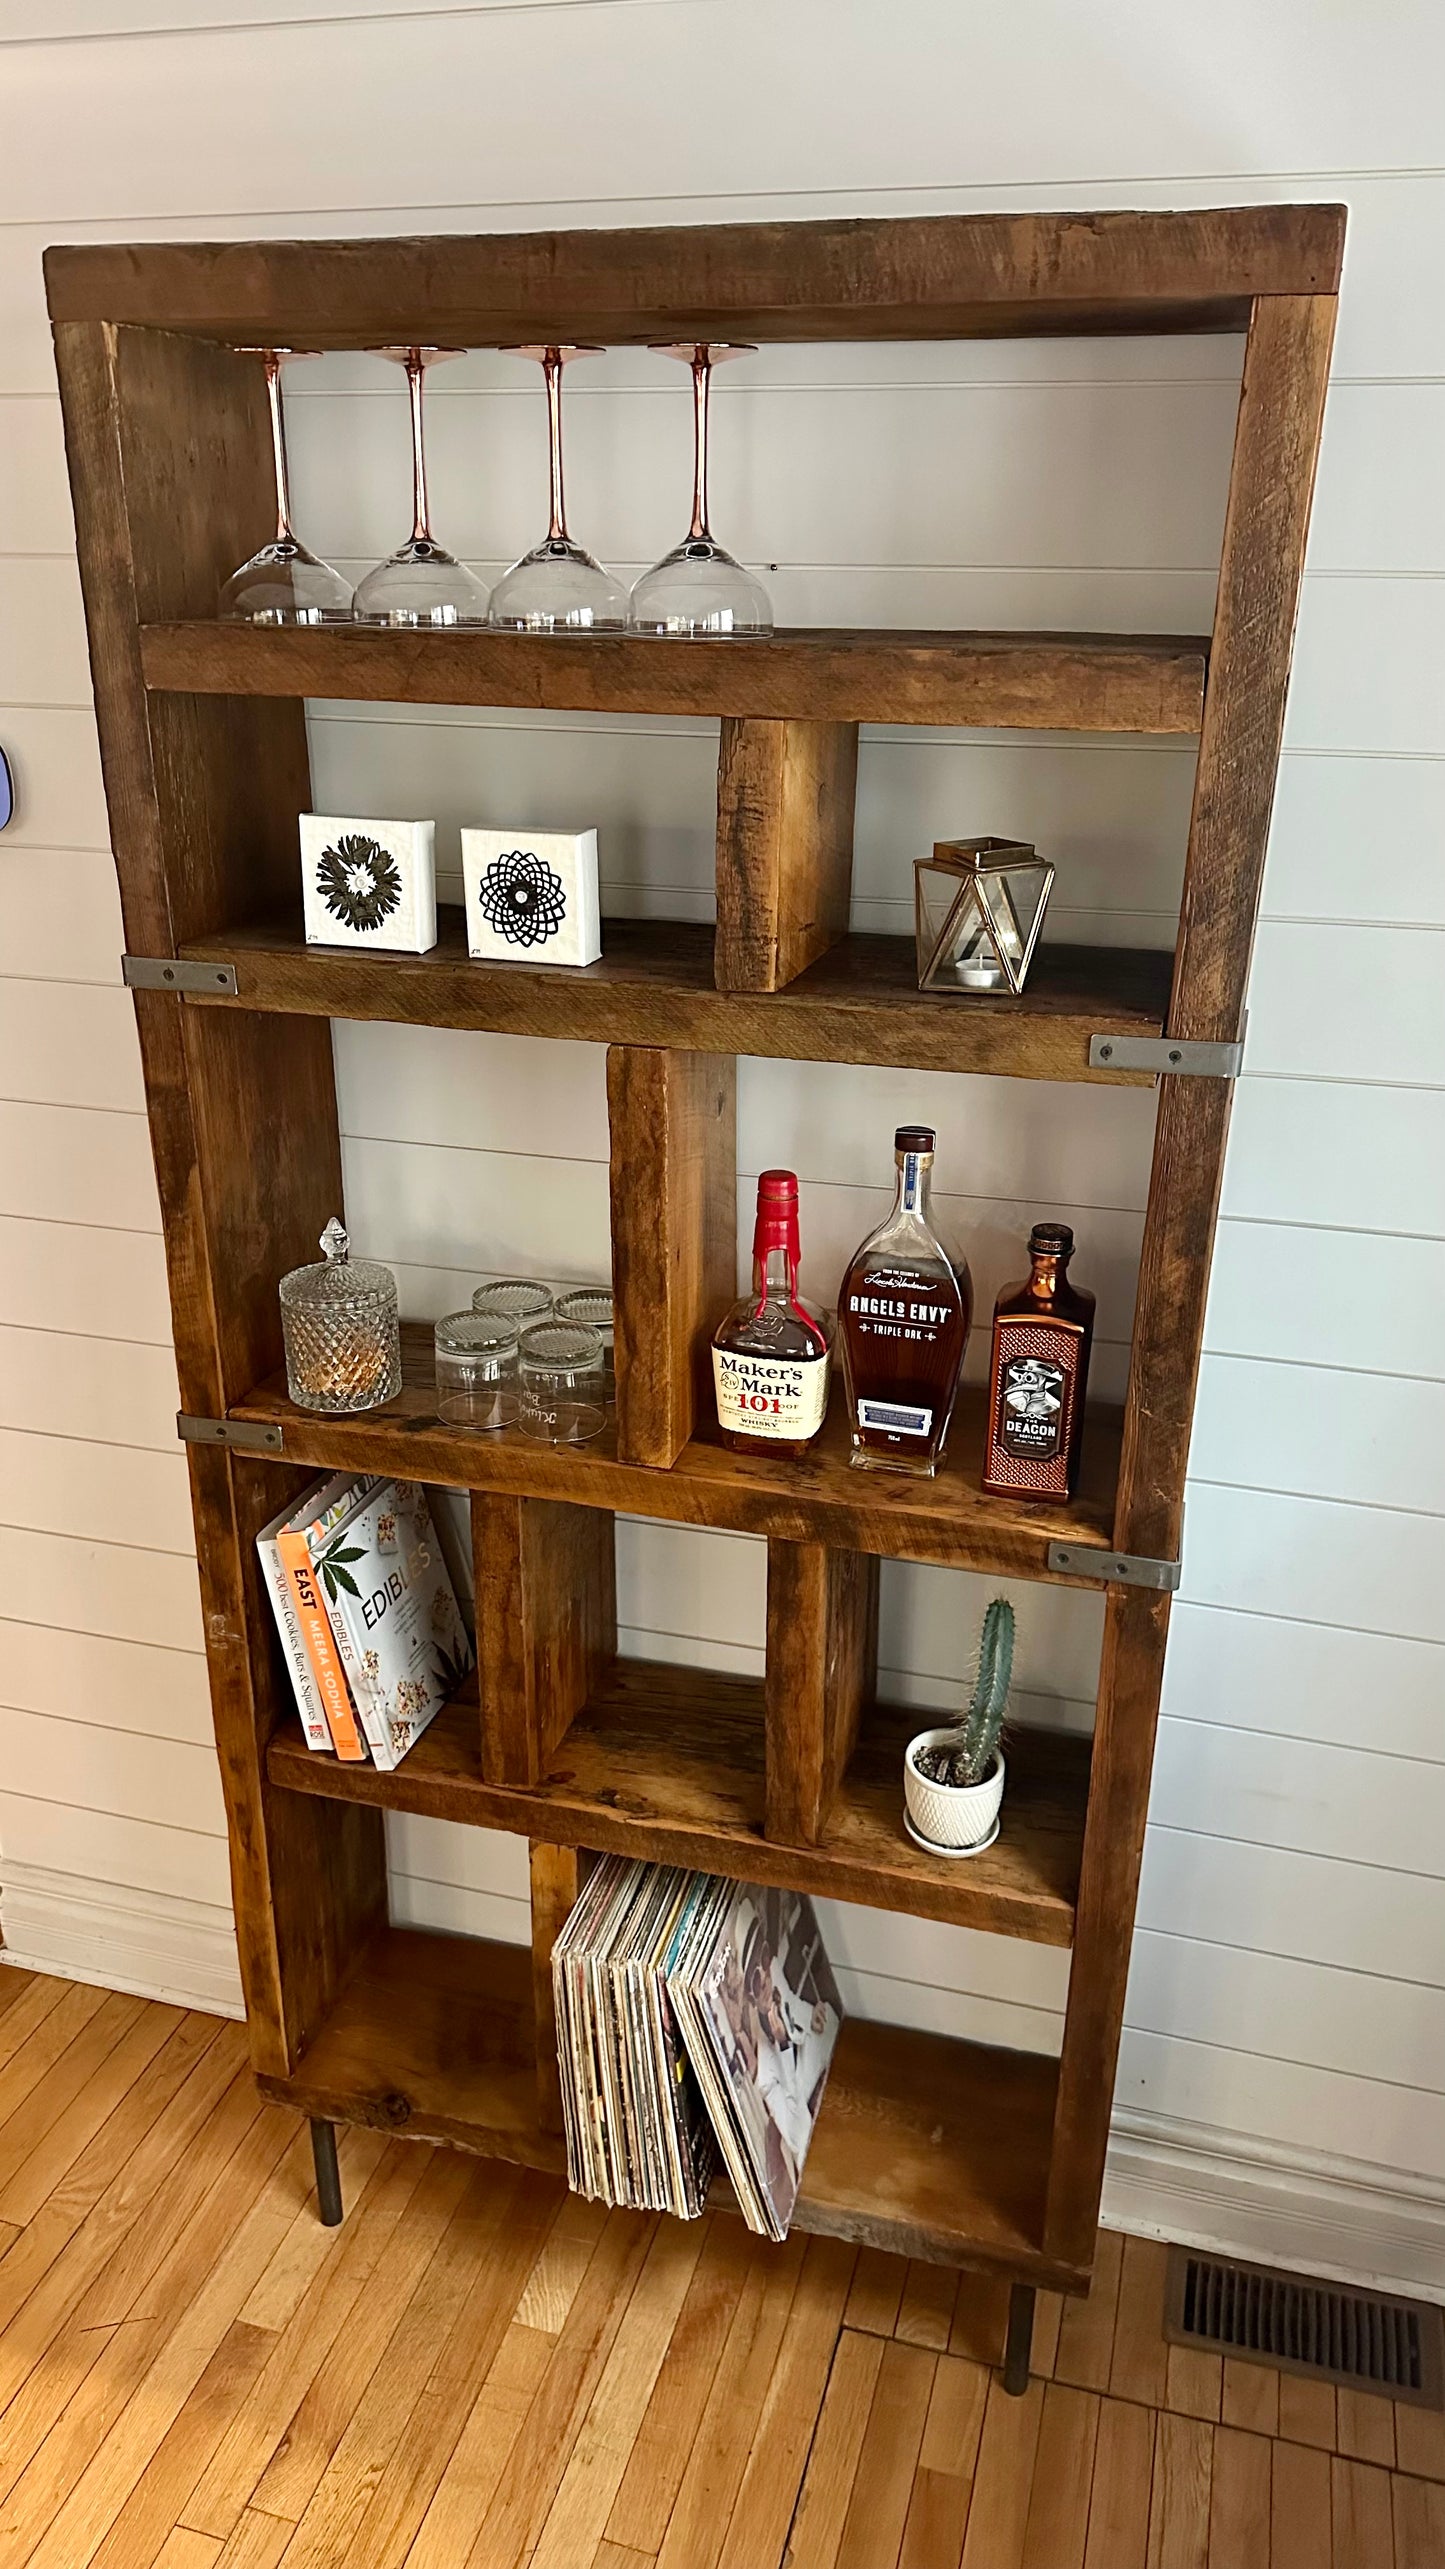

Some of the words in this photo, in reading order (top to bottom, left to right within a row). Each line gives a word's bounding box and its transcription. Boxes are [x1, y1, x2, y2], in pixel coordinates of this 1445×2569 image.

[910, 1303, 948, 1323] ENVY
[873, 1324, 902, 1337] TRIPLE
[904, 1328, 922, 1340] OAK
[719, 1355, 803, 1380] Maker's
[740, 1377, 801, 1397] Mark
[737, 1393, 783, 1414] 101
[740, 1417, 778, 1428] WHISKY
[1006, 1420, 1056, 1437] DEACON
[273, 1573, 288, 1592] 500
[361, 1542, 431, 1631] EDIBLES
[279, 1593, 290, 1610] best
[283, 1611, 302, 1651] Cookies,
[330, 1612, 354, 1661] EDIBLES
[293, 1568, 317, 1609] EAST
[308, 1620, 330, 1666] MEERA
[322, 1670, 344, 1719] SODHA
[295, 1652, 306, 1673] Bars
[299, 1674, 310, 1684] &
[301, 1684, 318, 1721] Squares
